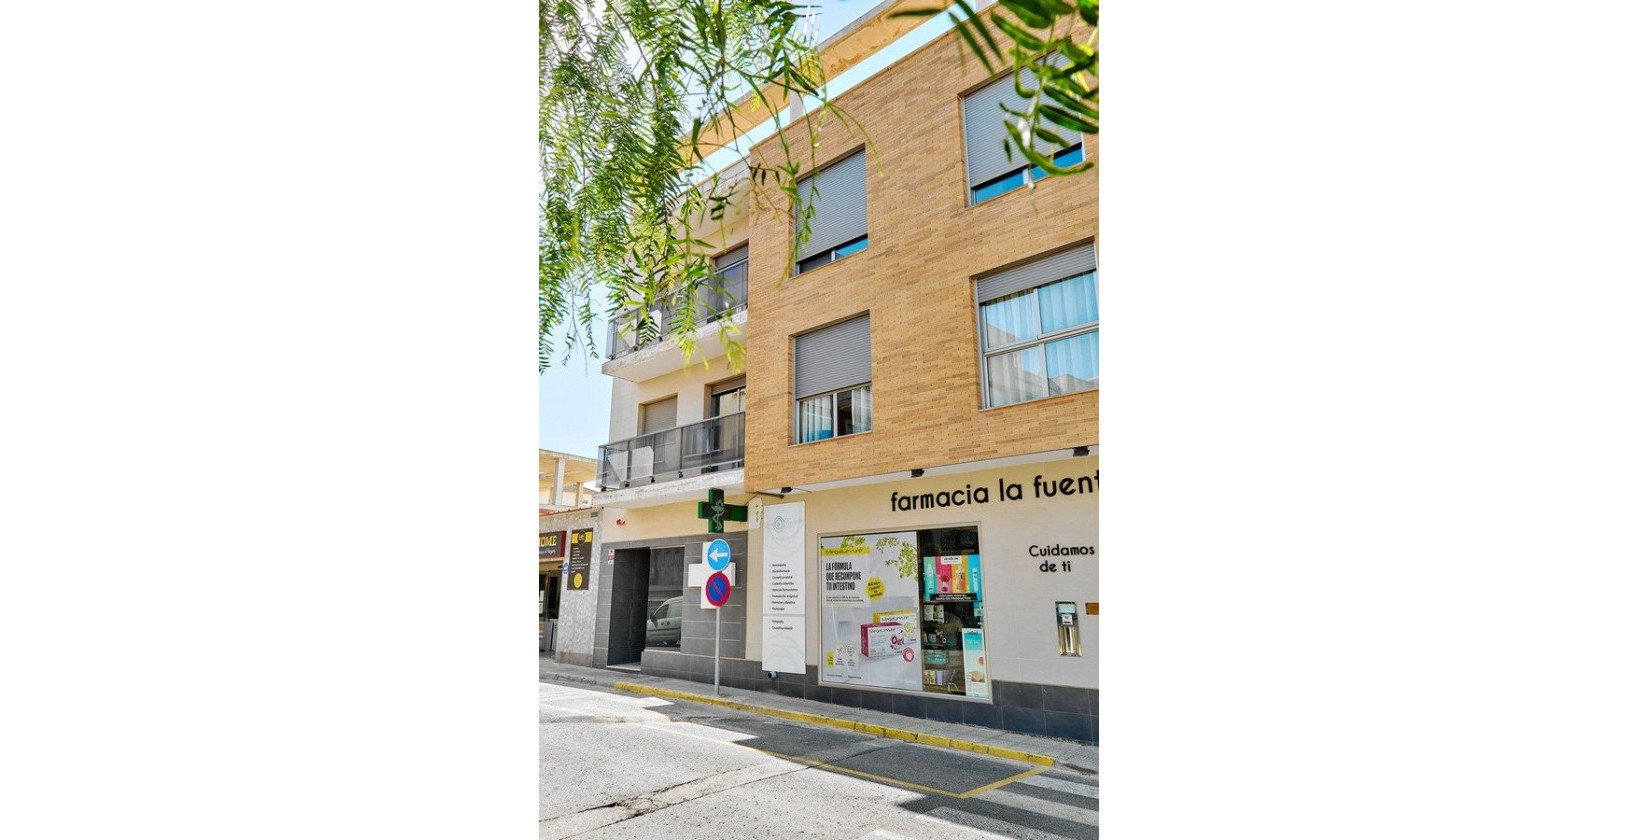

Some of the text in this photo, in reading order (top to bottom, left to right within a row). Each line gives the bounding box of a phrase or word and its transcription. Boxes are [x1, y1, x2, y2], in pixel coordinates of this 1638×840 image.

[891, 484, 989, 512] farmacia
[999, 478, 1023, 502] la
[1029, 545, 1095, 557] Cuidamos
[826, 562, 831, 571] LA
[1040, 560, 1071, 573] de ti
[826, 571, 861, 581] QUE RECOMPONE
[826, 581, 855, 591] TU INTESTINO
